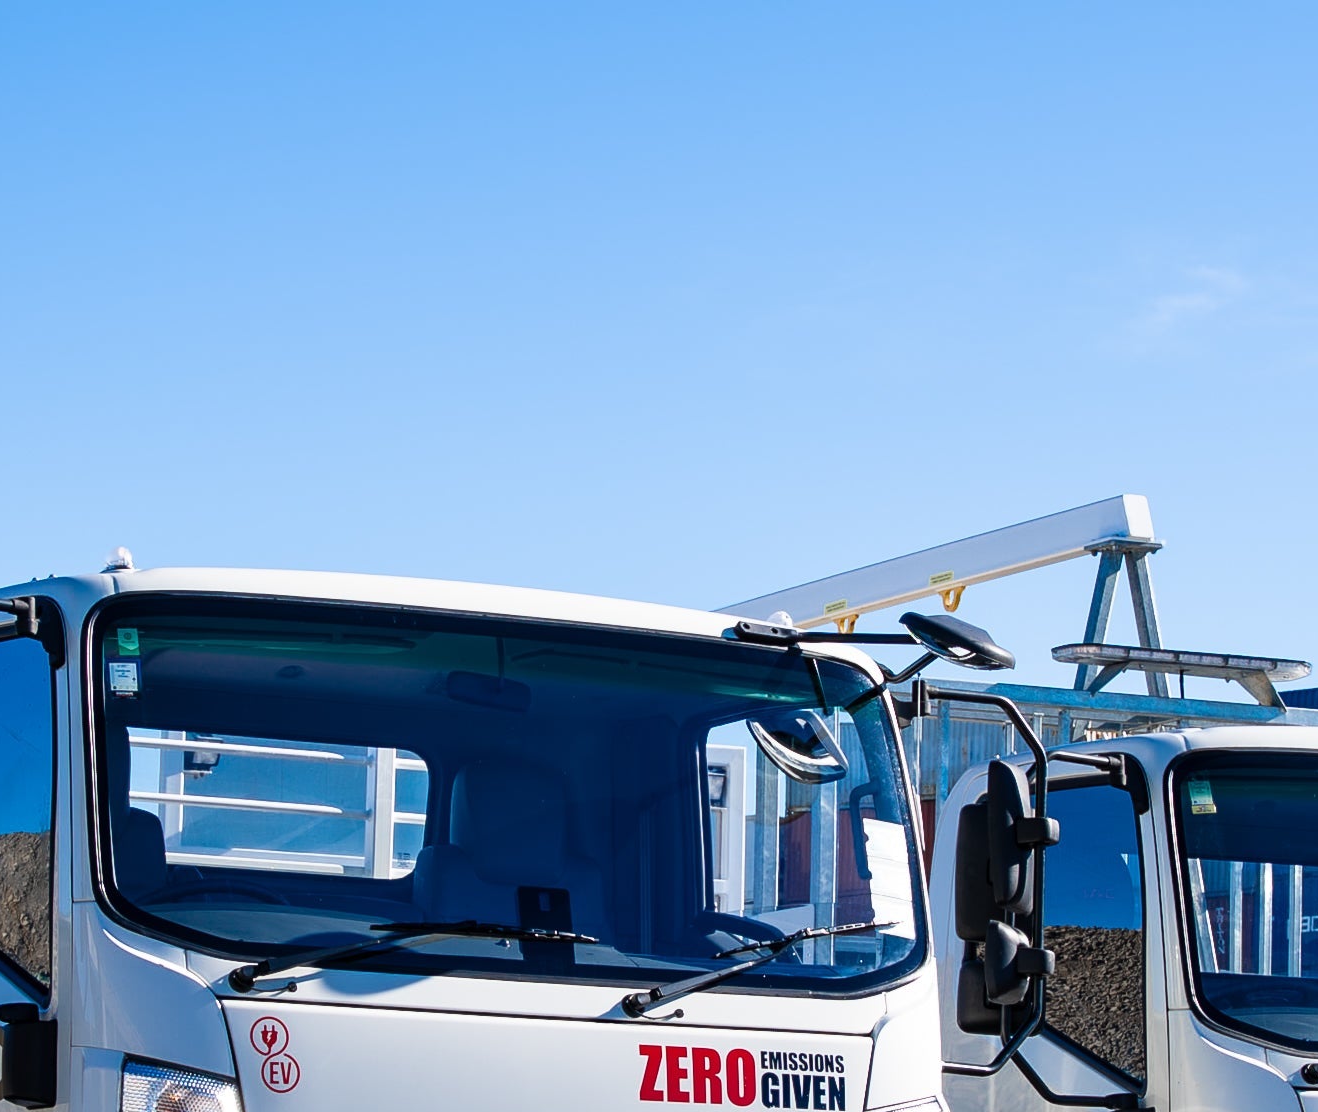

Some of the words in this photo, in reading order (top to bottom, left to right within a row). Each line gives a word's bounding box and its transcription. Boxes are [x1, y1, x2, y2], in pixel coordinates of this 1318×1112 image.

[269, 1061, 292, 1085] EV
[639, 1044, 757, 1107] ZERO
[760, 1050, 845, 1074] EMISSIONS
[760, 1072, 846, 1112] GIVEN
